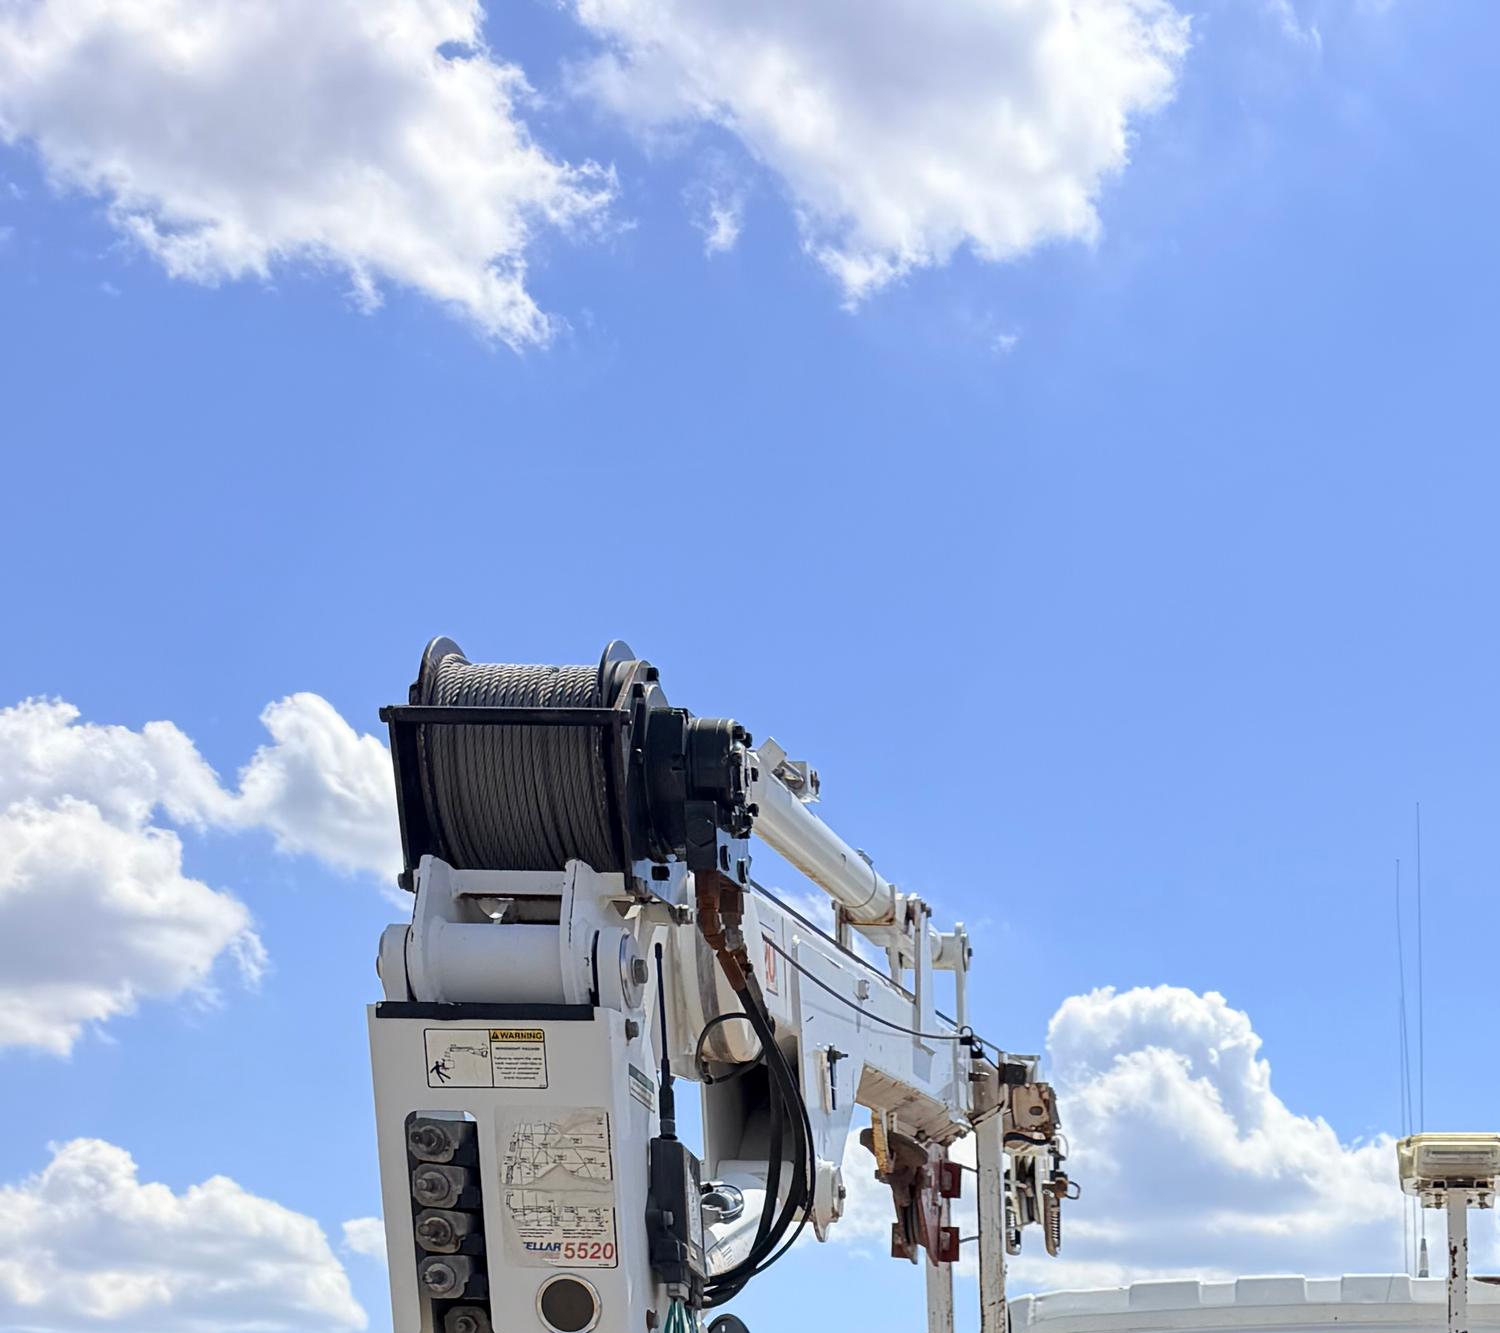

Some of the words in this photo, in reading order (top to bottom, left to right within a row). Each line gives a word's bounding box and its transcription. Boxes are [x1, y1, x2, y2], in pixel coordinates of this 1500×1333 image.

[500, 1031, 542, 1040] WARNING
[523, 1241, 561, 1252] ELLAR
[564, 1242, 614, 1260] 5520
